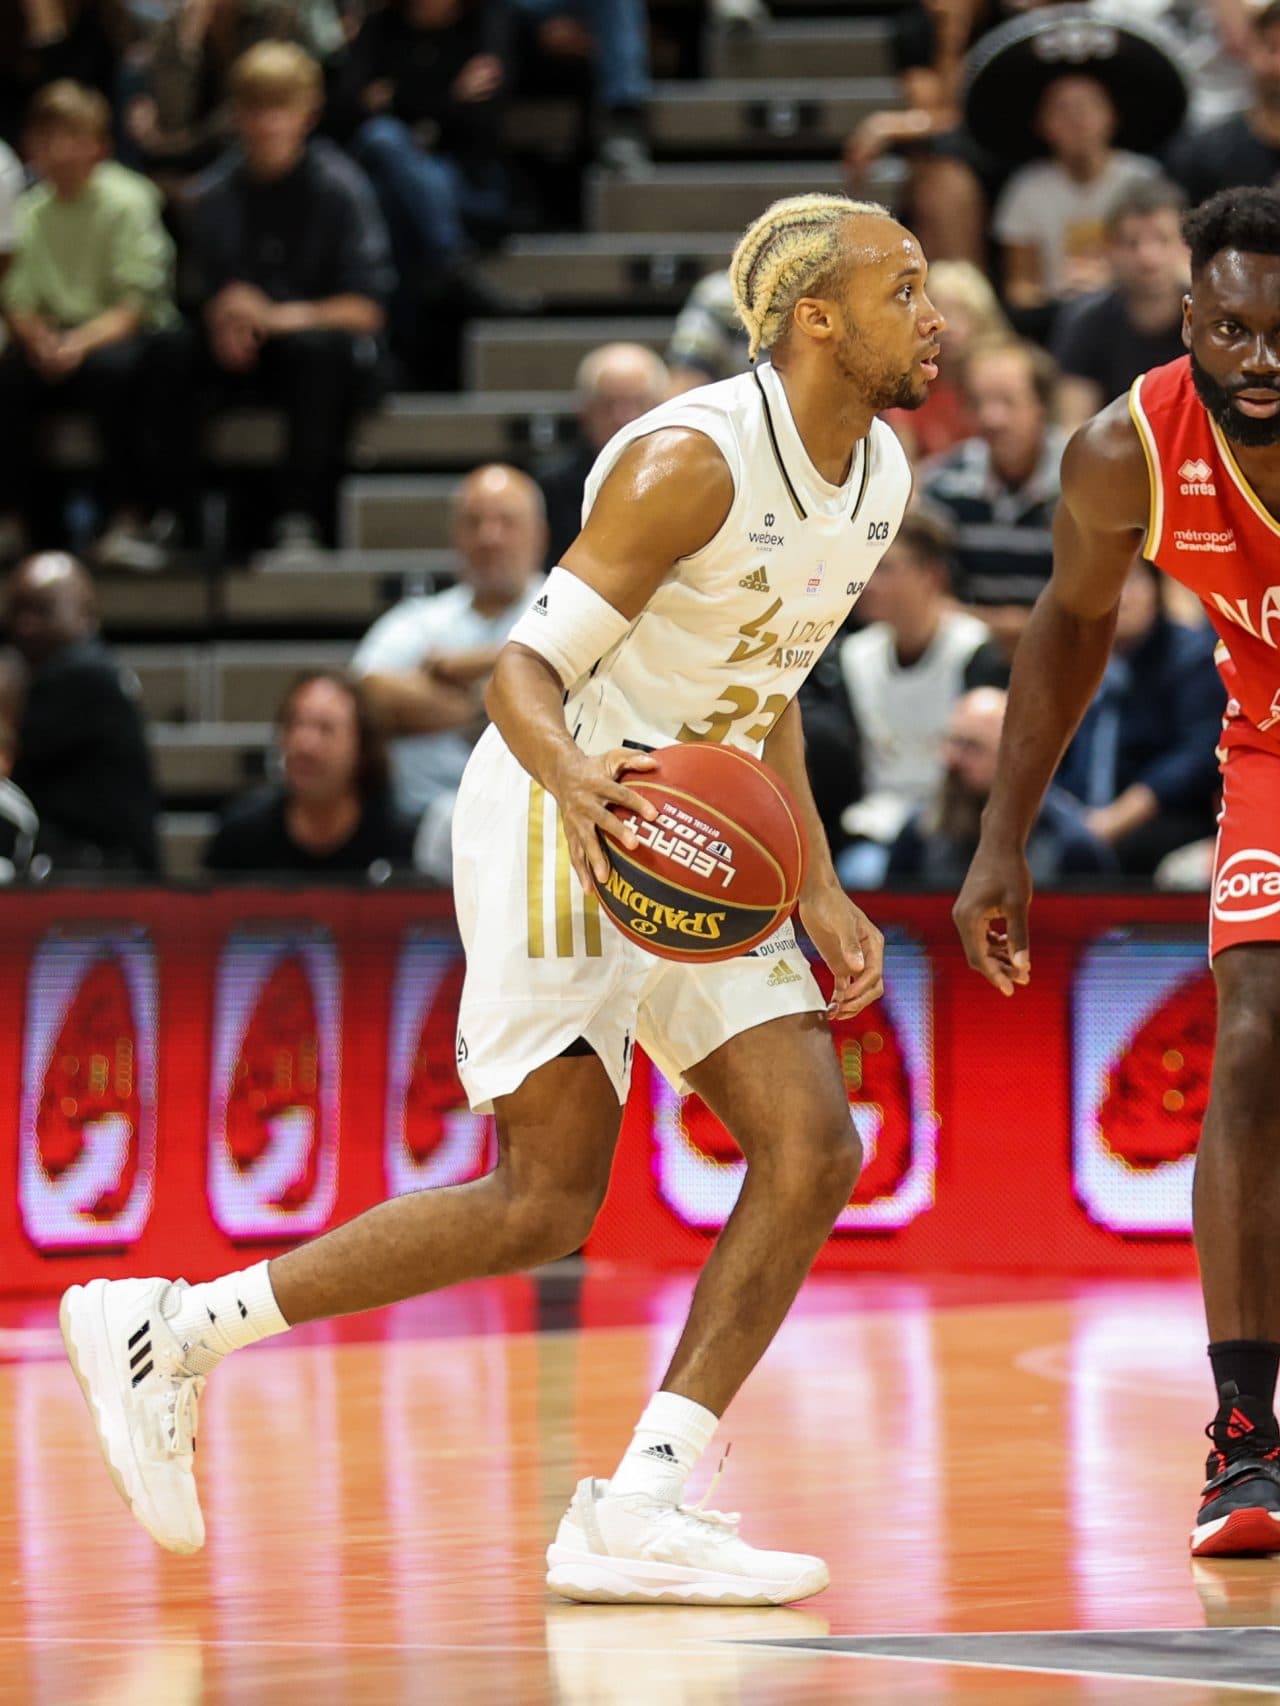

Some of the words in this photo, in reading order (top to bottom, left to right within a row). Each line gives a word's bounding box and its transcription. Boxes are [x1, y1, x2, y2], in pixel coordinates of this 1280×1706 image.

[749, 531, 785, 546] webex
[867, 521, 889, 541] DCB
[623, 815, 737, 888] LEGACY
[605, 867, 726, 939] SPALDIN
[760, 941, 775, 957] DU
